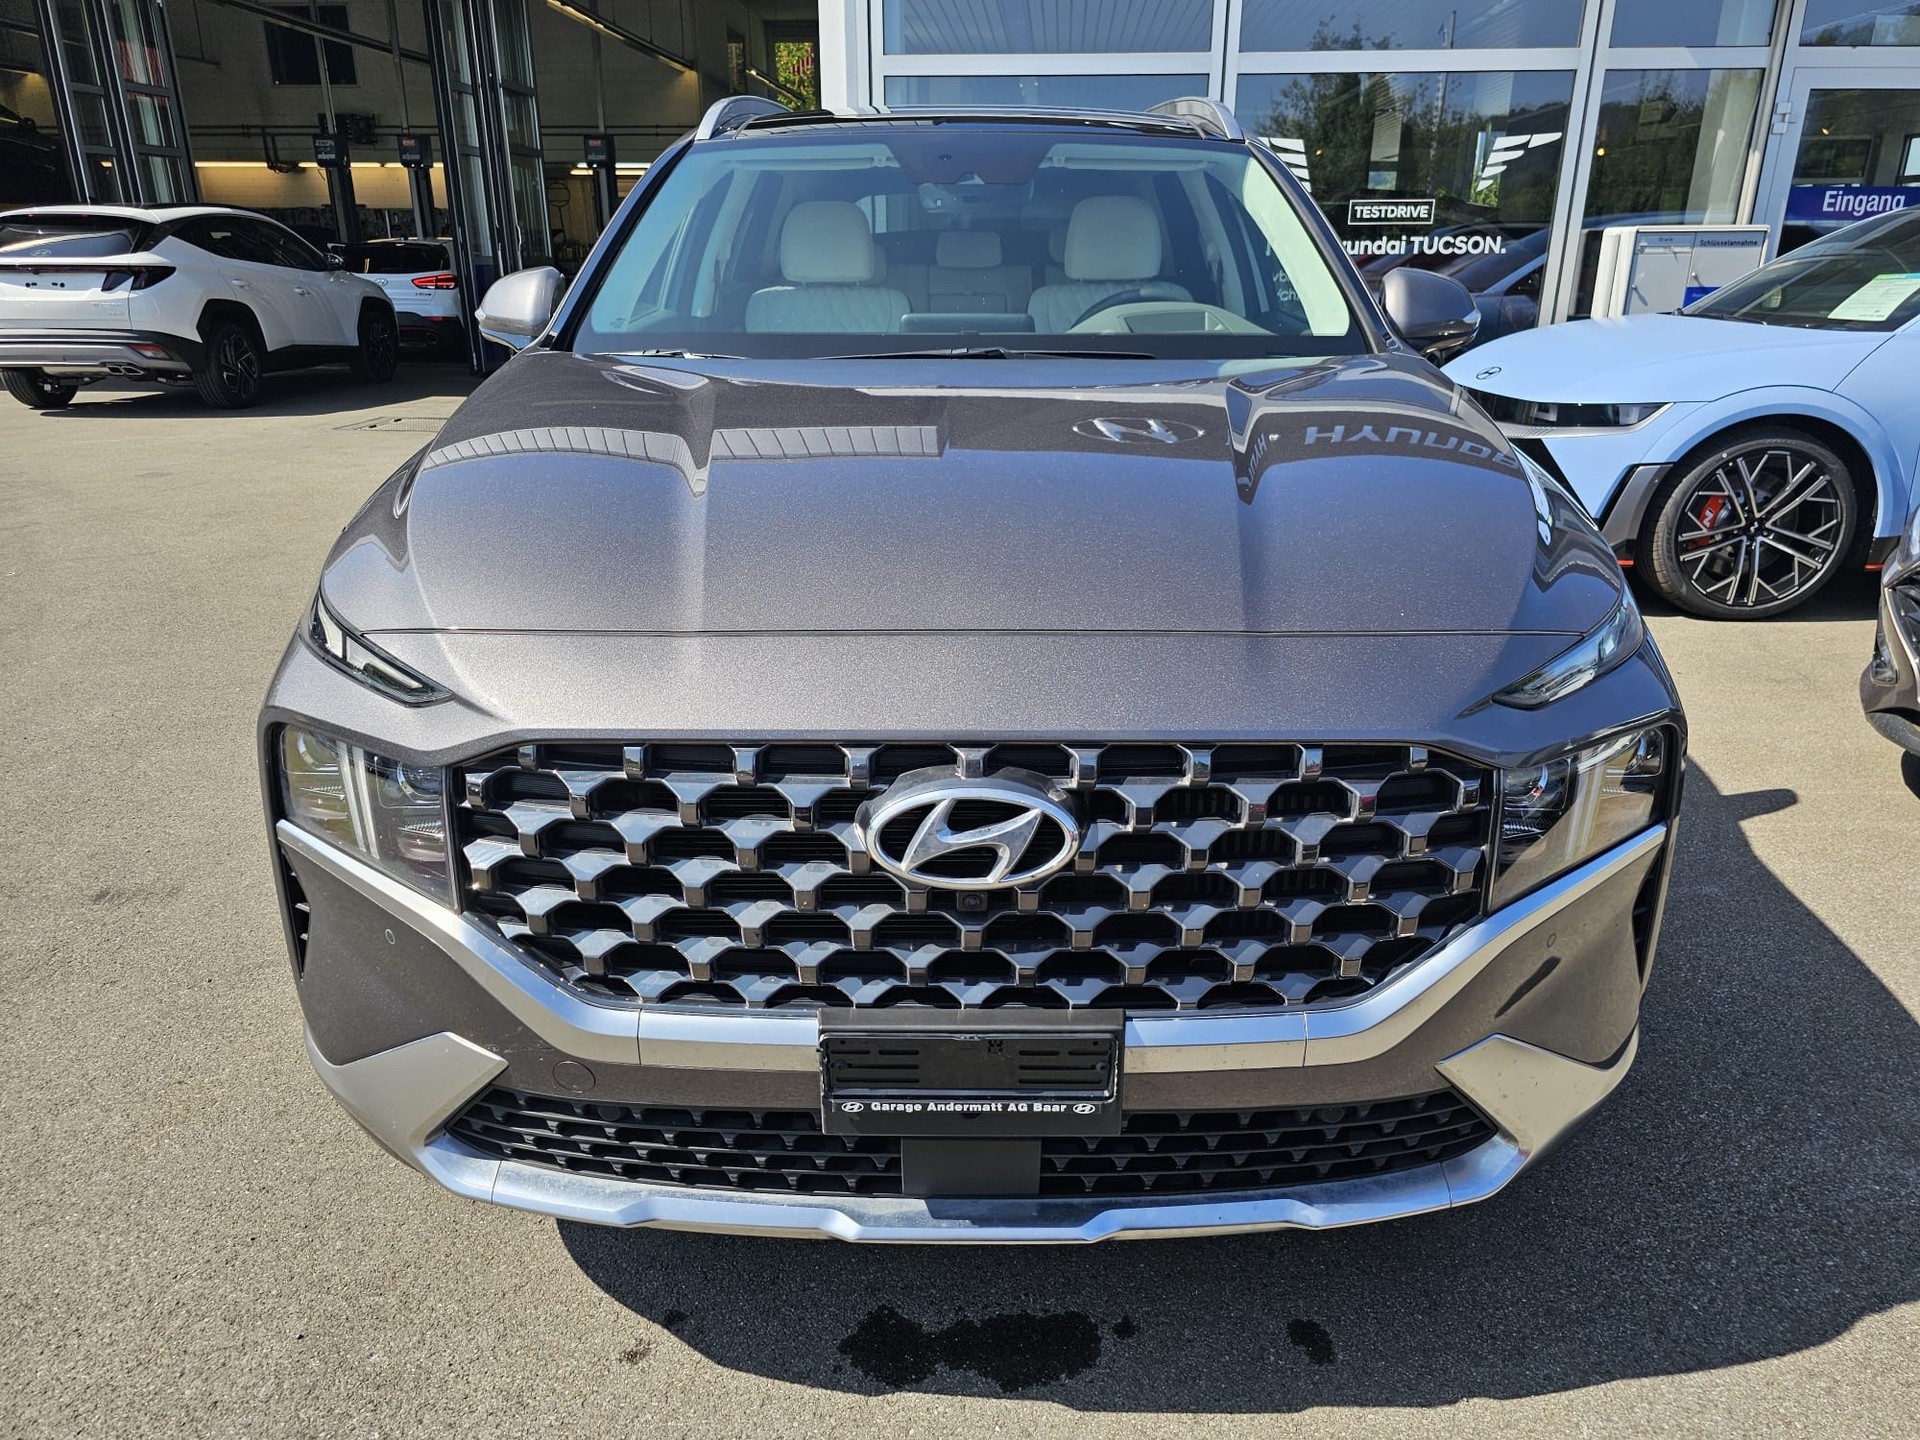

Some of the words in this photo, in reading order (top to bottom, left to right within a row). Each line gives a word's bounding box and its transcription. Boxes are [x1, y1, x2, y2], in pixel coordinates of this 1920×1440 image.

[1354, 205, 1429, 219] TESTDRIVE
[1410, 235, 1506, 255] TUCSON.
[870, 1101, 922, 1113] Garage
[927, 1102, 1003, 1112] Andermatt
[1007, 1102, 1028, 1112] AG
[1033, 1102, 1067, 1113] Baar
